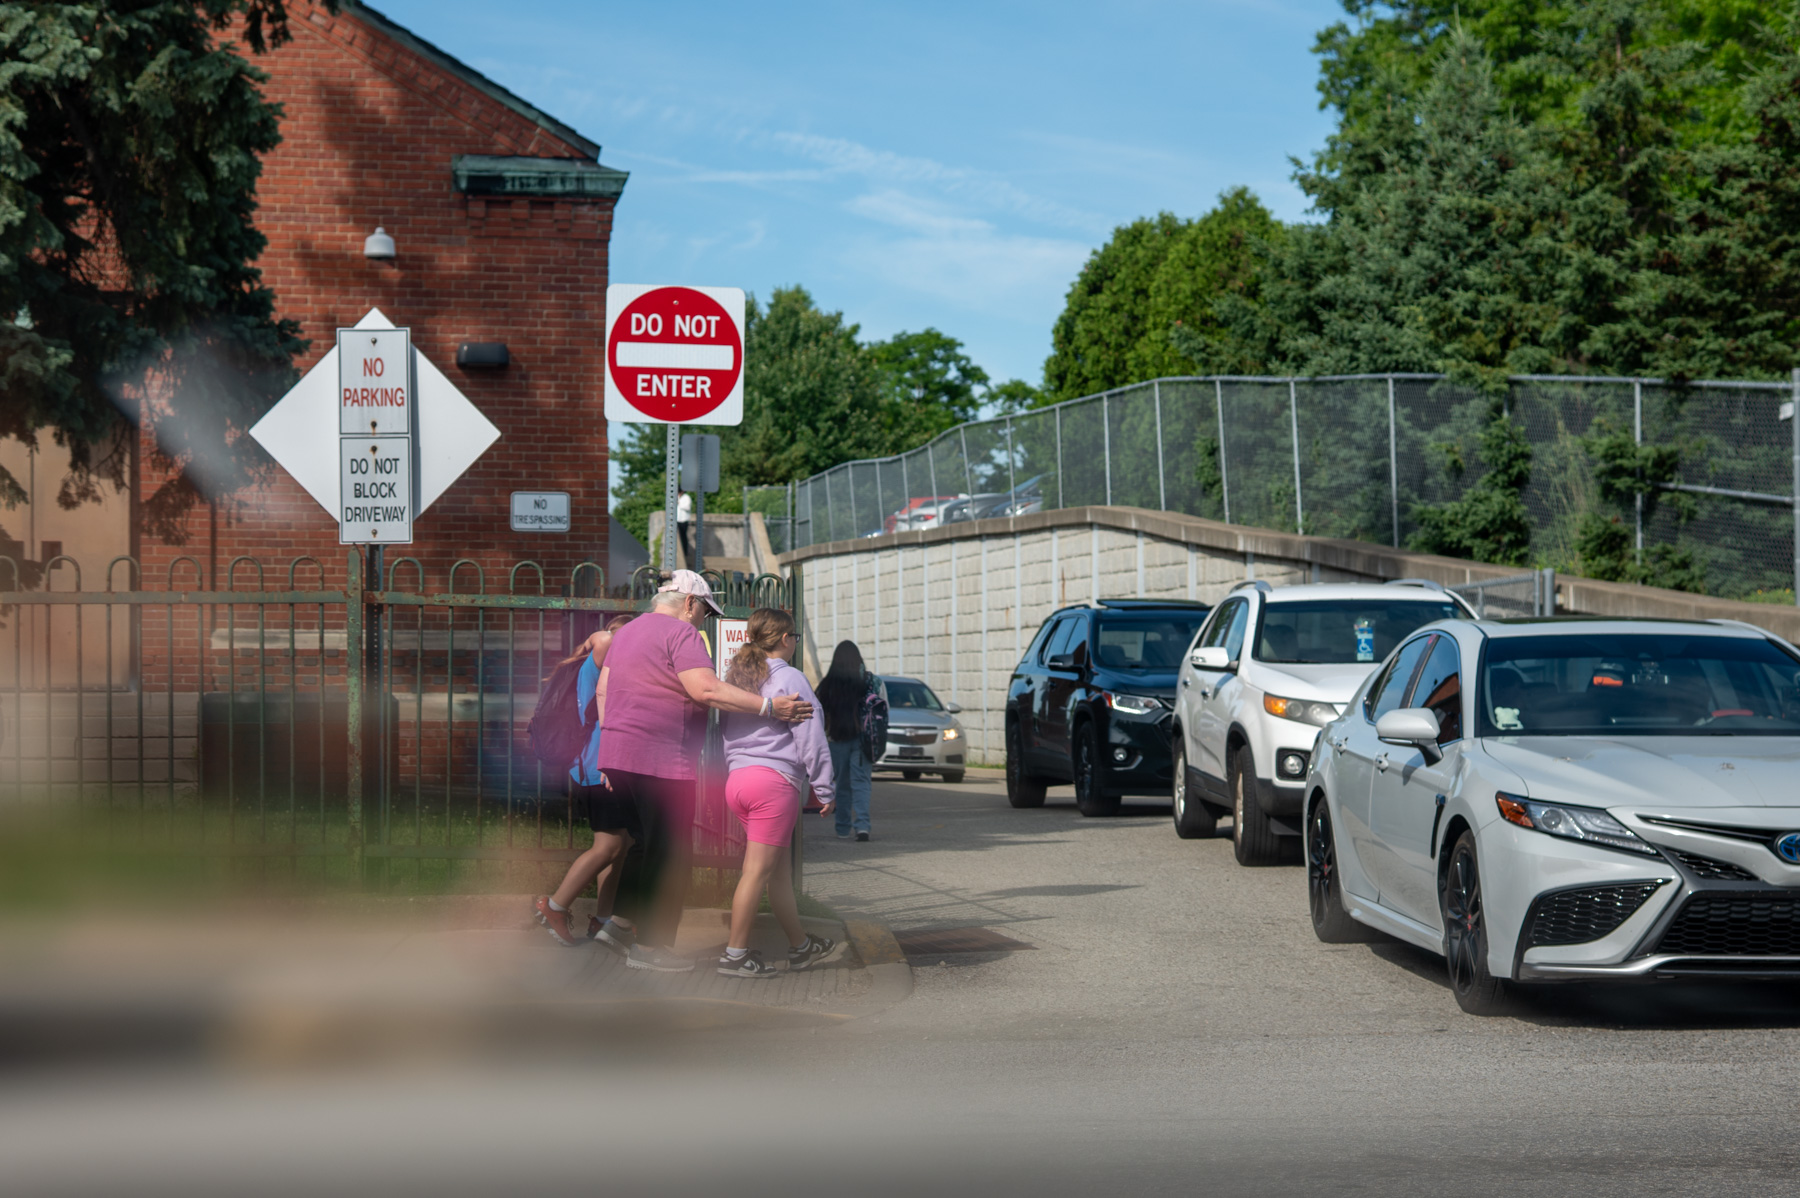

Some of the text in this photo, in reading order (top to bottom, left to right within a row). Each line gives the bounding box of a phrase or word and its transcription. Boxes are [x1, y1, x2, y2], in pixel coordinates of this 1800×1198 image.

[631, 313, 720, 338] DO NOT
[363, 357, 384, 377] NO
[636, 374, 711, 399] ENTER
[343, 387, 405, 407] PARKING
[350, 458, 400, 475] DO NOT
[354, 482, 397, 499] BLOCK
[533, 499, 548, 510] NO
[345, 506, 406, 522] DRIVEWAY
[514, 514, 568, 525] TRESPASSING
[725, 629, 752, 643] WAR
